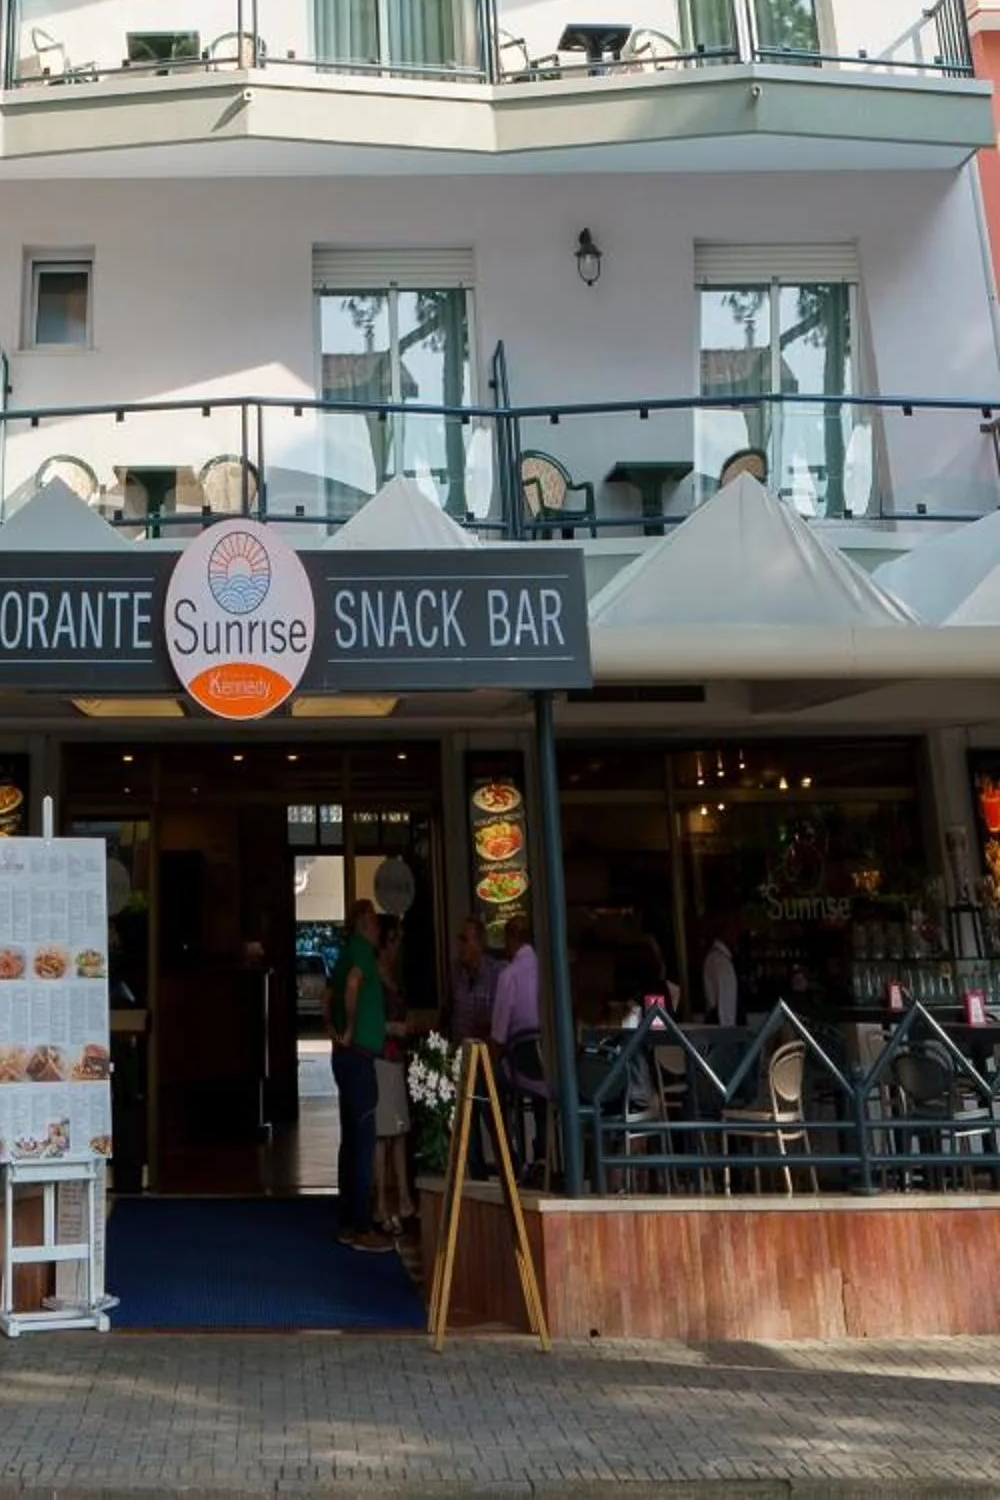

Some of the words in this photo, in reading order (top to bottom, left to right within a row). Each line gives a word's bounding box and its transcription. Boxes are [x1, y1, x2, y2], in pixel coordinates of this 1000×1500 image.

[173, 598, 308, 655] Sunrise
[334, 589, 466, 649] SNACK
[487, 588, 565, 647] BAR
[765, 883, 852, 920] Sunrise
